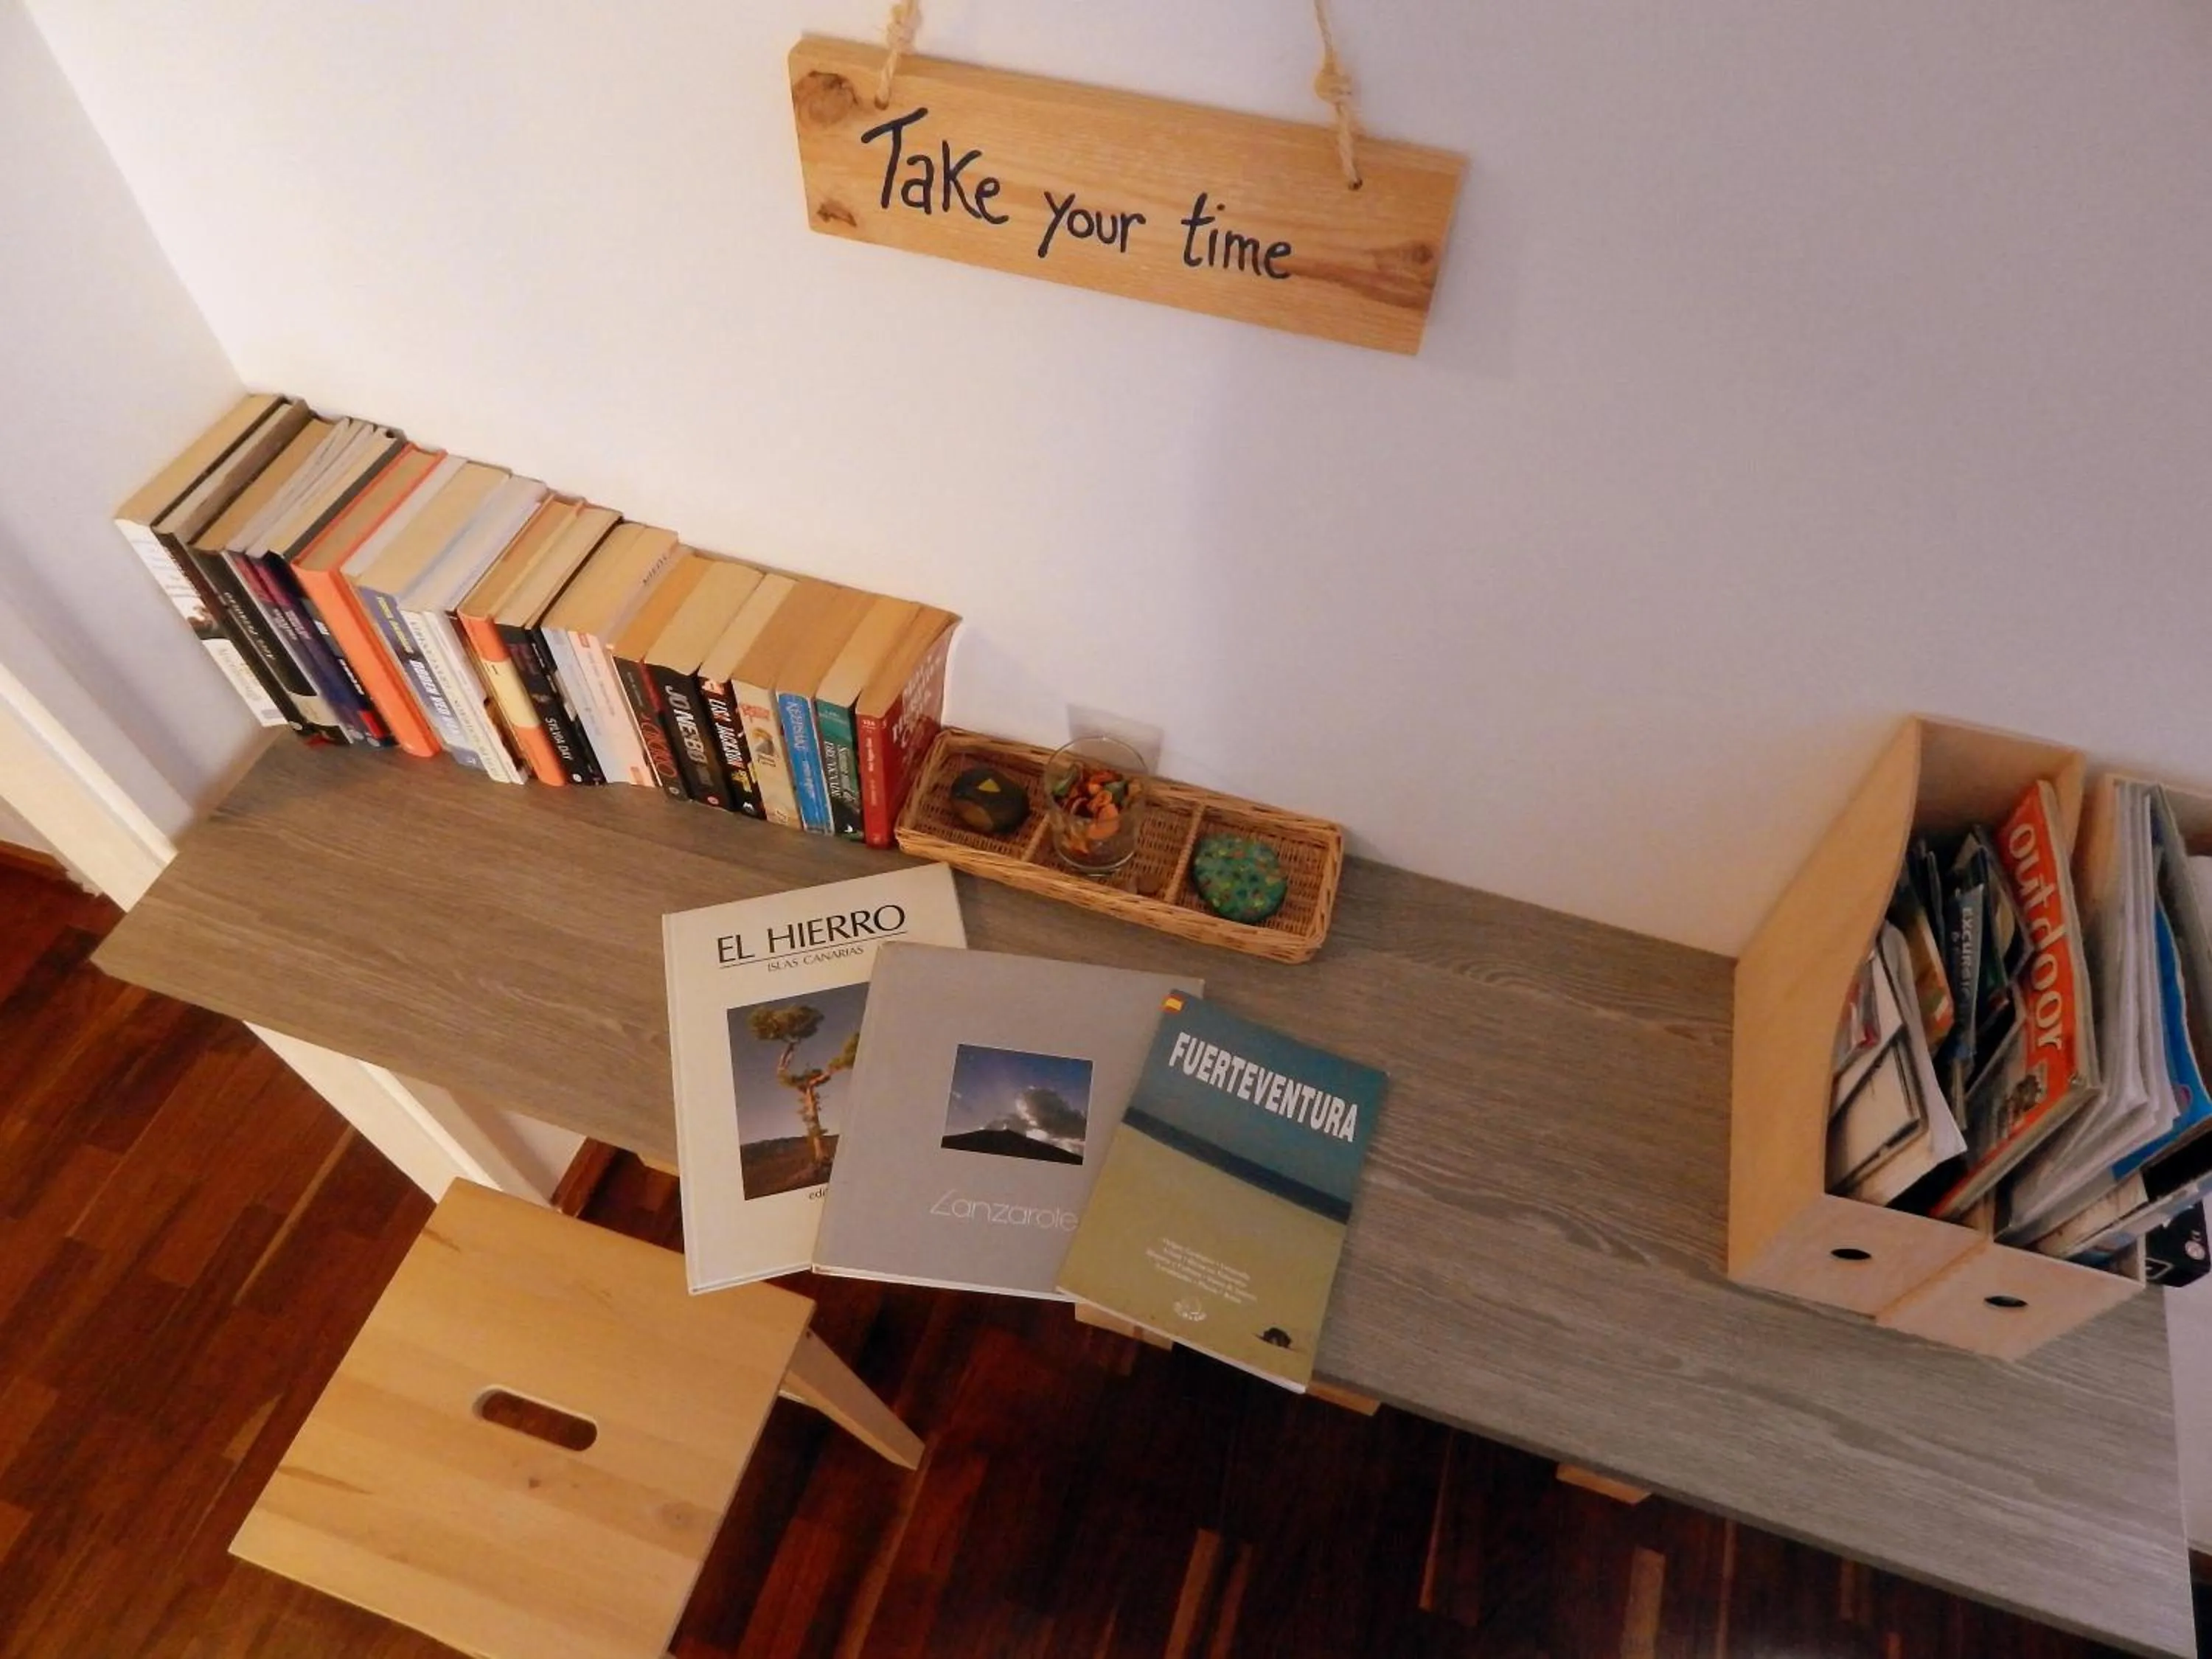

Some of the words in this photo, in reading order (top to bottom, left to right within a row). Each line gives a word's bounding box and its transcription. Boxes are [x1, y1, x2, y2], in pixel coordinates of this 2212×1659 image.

[860, 107, 1009, 225] Take
[1037, 191, 1146, 258] your
[1180, 192, 1295, 279] time
[665, 684, 687, 707] JO
[717, 934, 755, 963] EL
[767, 905, 905, 953] HIERRO
[768, 960, 799, 972] ISLAS
[803, 947, 864, 965] CANARIAS
[2008, 822, 2067, 1051] outdoor
[1169, 1032, 1358, 1143] FUERTEVENTURA
